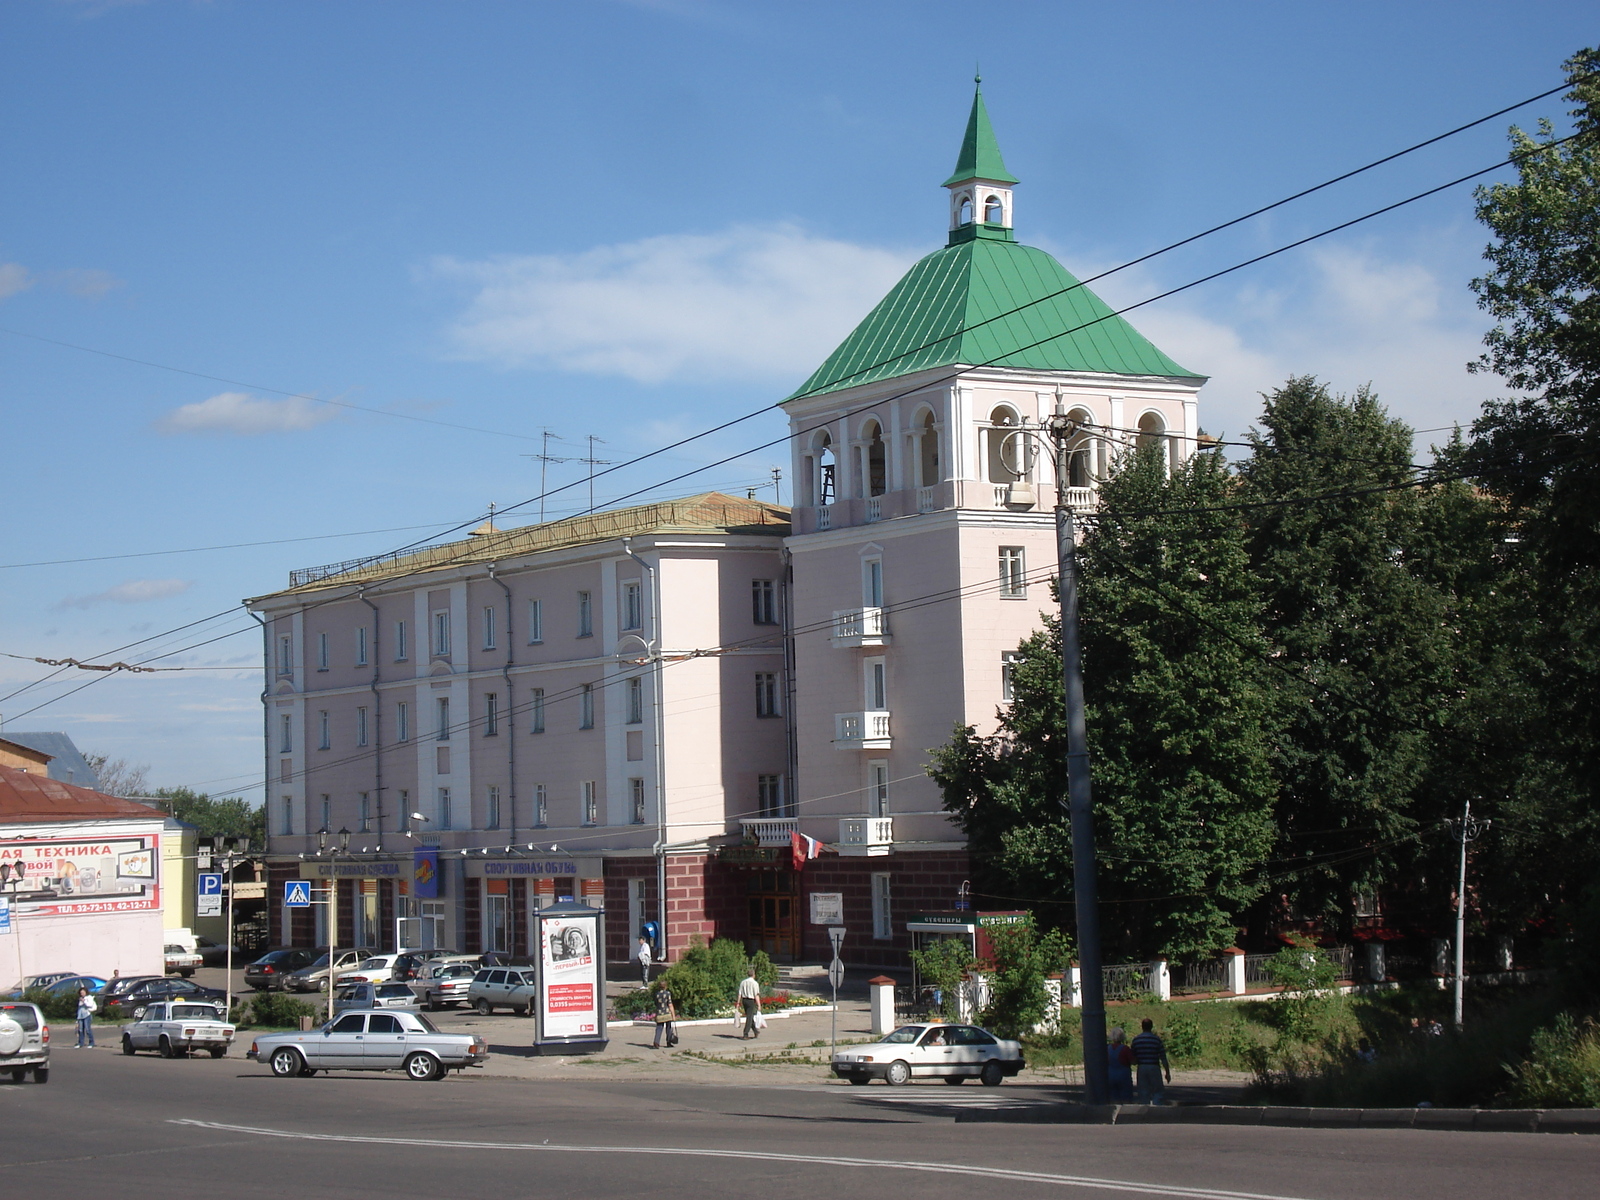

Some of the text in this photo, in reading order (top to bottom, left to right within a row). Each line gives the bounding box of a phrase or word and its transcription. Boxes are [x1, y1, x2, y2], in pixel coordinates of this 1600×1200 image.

[34, 845, 112, 857] ТЕХНИКА
[484, 861, 577, 875] СПОРТИВНАЯ ОБУВЬ
[57, 901, 152, 913] ТЕЛ. 32-72-13, 42-12-71
[924, 917, 961, 925] СУВЕНИРЫ
